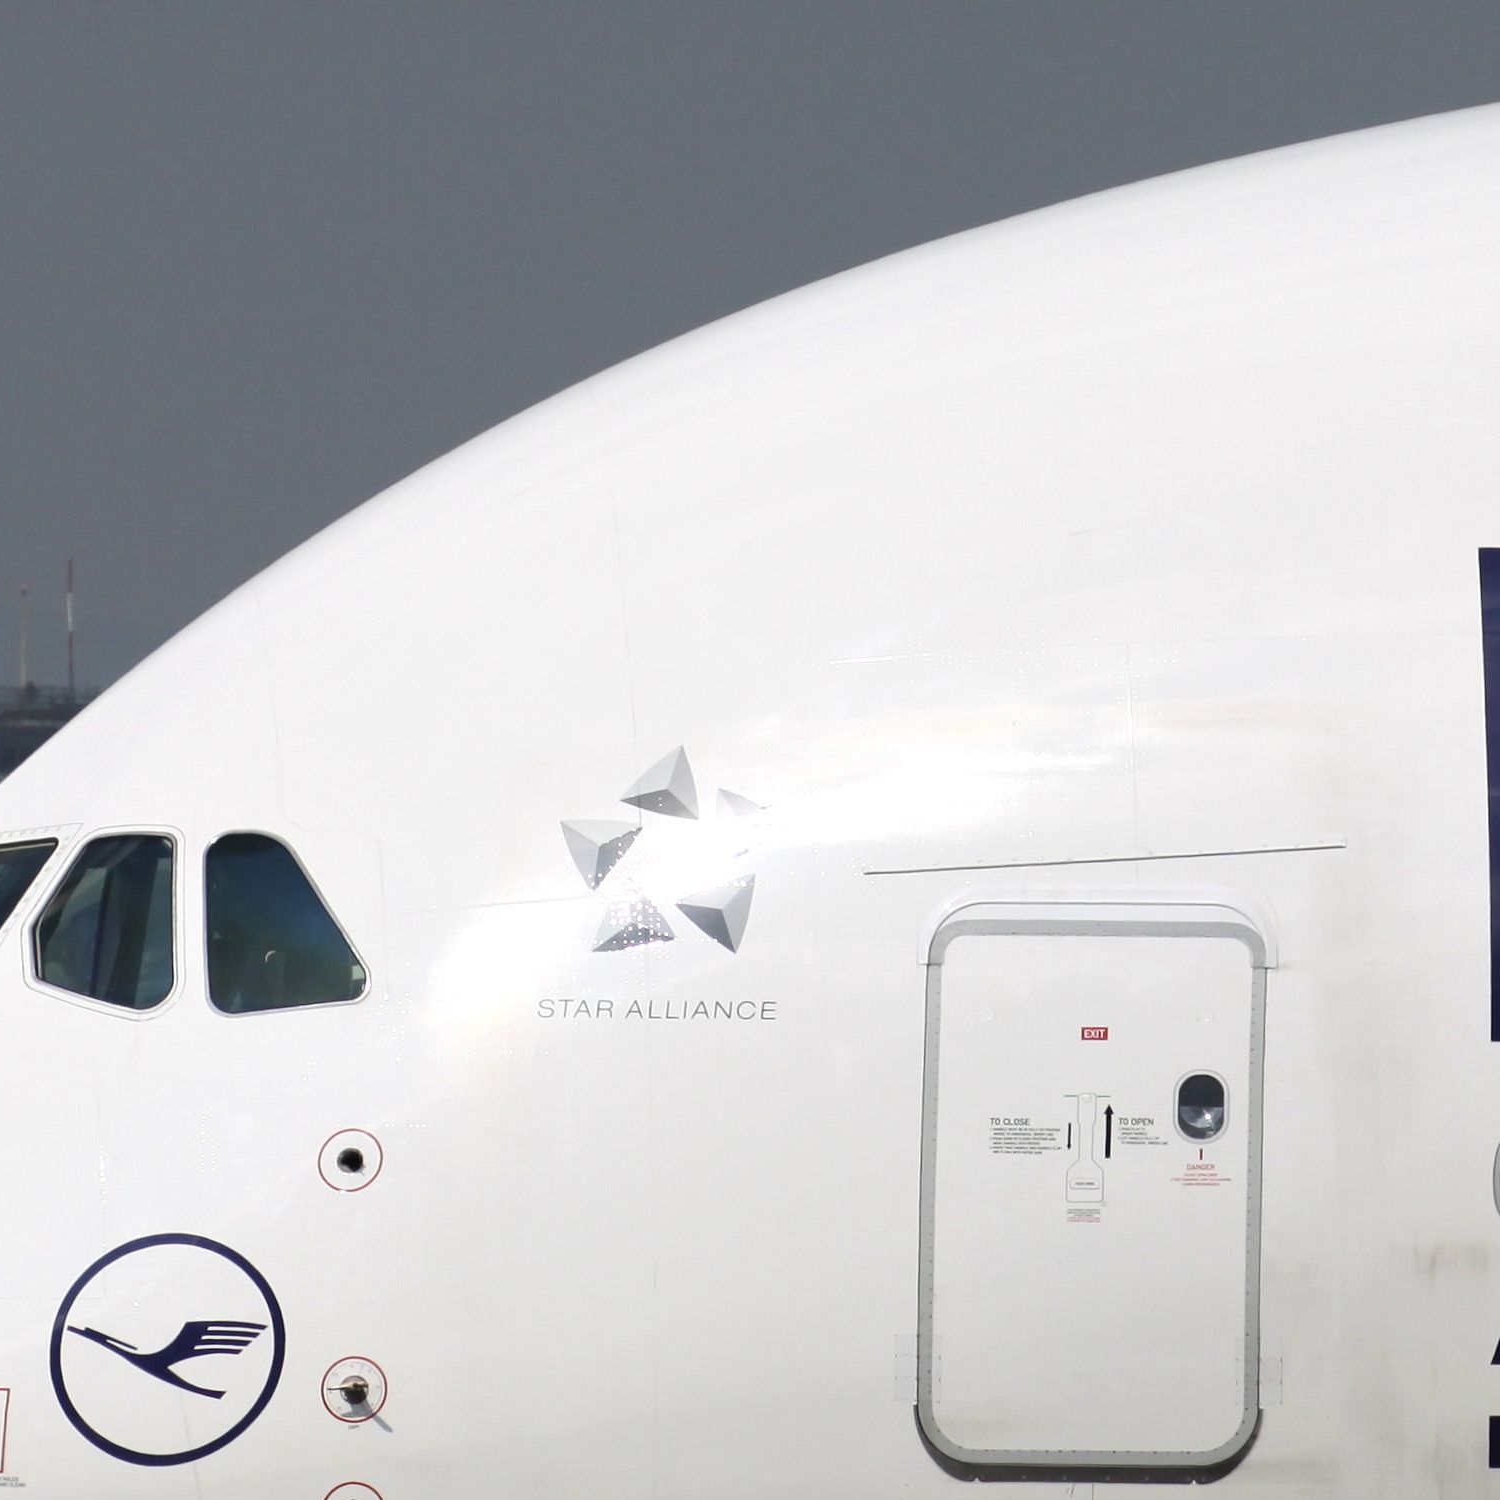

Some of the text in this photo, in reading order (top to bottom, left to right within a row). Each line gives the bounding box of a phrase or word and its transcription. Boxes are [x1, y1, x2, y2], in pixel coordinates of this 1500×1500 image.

[537, 999, 777, 1020] STAR ALLIANCE
[1083, 1029, 1106, 1039] EXIT
[990, 1118, 1030, 1126] TO CLOSE
[1131, 1118, 1154, 1126] OPEN
